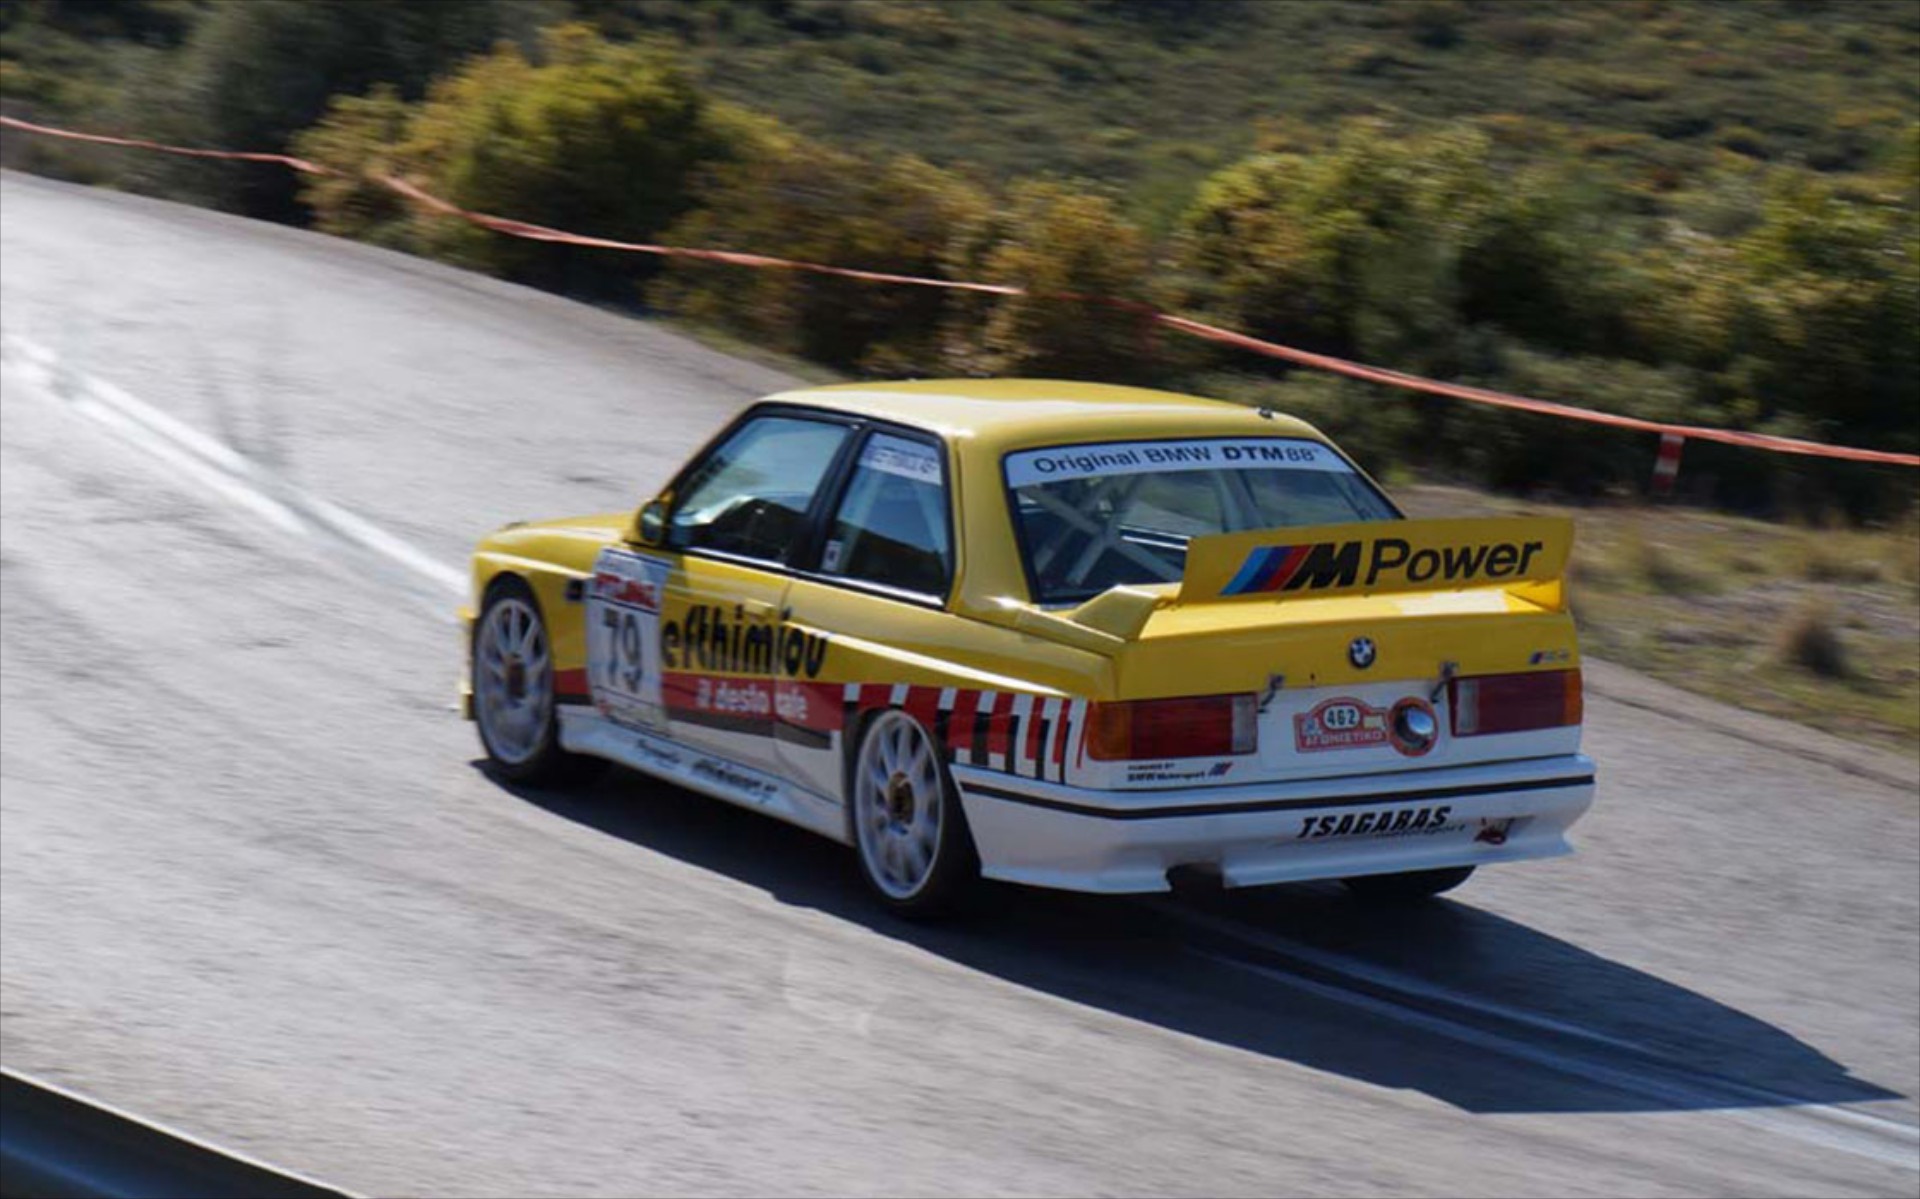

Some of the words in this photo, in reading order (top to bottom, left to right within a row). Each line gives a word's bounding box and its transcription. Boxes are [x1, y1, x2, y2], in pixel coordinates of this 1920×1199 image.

[1033, 449, 1140, 474] Original
[1147, 446, 1212, 464] BMW
[604, 607, 644, 694] 79
[661, 603, 828, 680] efthimiou
[1326, 708, 1357, 728] 462
[1296, 806, 1452, 837] TSAGARAS
